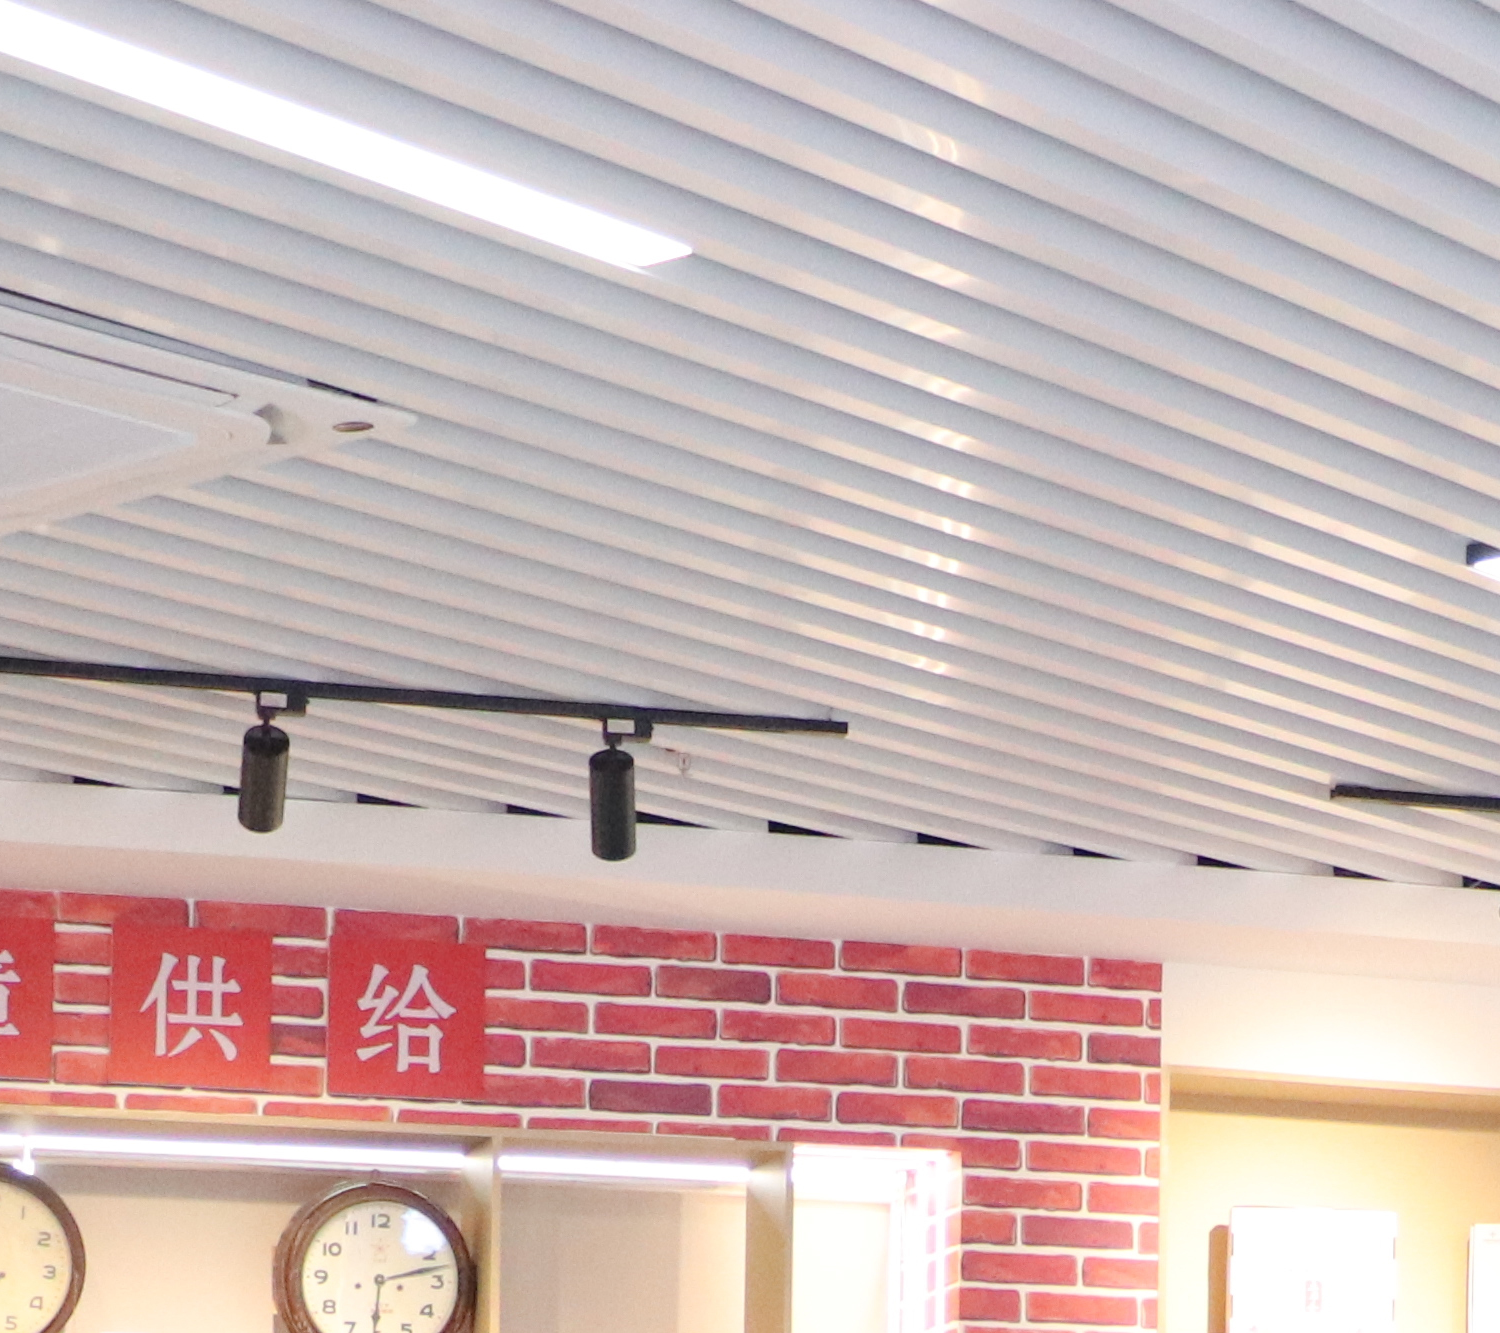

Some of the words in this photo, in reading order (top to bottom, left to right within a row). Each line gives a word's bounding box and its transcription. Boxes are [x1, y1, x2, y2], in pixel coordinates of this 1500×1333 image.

[21, 1206, 25, 1220] 1
[371, 1213, 391, 1229] 12
[345, 1221, 358, 1236] 11
[37, 1231, 51, 1246] 2
[323, 1242, 342, 1256] 10
[43, 1265, 56, 1279] 3
[314, 1270, 329, 1284] 9
[431, 1275, 444, 1289] 3
[322, 1299, 336, 1314] 8
[419, 1303, 434, 1318] 4
[5, 1316, 18, 1330] 5
